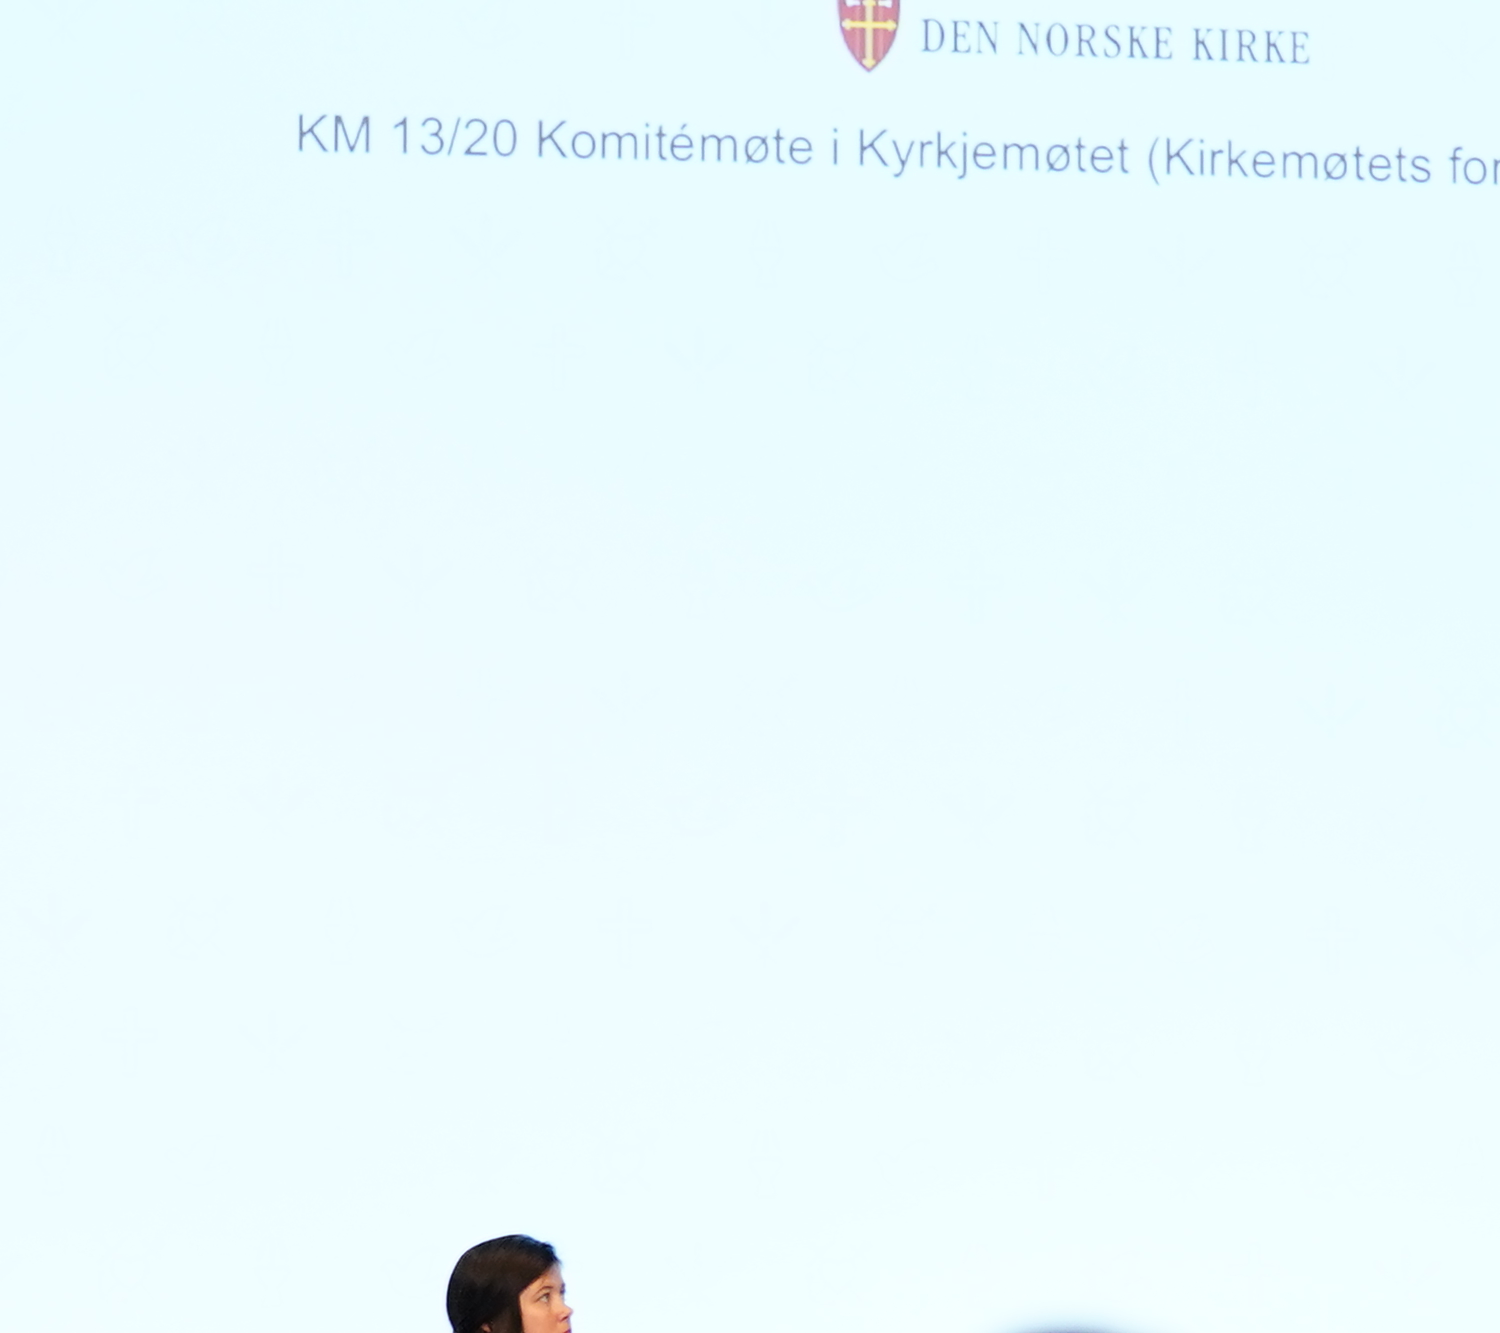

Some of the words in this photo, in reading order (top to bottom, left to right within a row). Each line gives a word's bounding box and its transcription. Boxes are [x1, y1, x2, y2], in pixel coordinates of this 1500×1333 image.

[921, 18, 999, 55] DEN
[1017, 21, 1173, 61] NORSKE
[1192, 27, 1311, 65] KIRKE
[297, 113, 371, 154] KM
[392, 115, 518, 158] 13/20
[537, 119, 814, 166] Komitémøte
[832, 127, 839, 166] i
[858, 128, 1130, 181] Kyrkjemøtet
[1147, 136, 1435, 186] (Kirkemøtets
